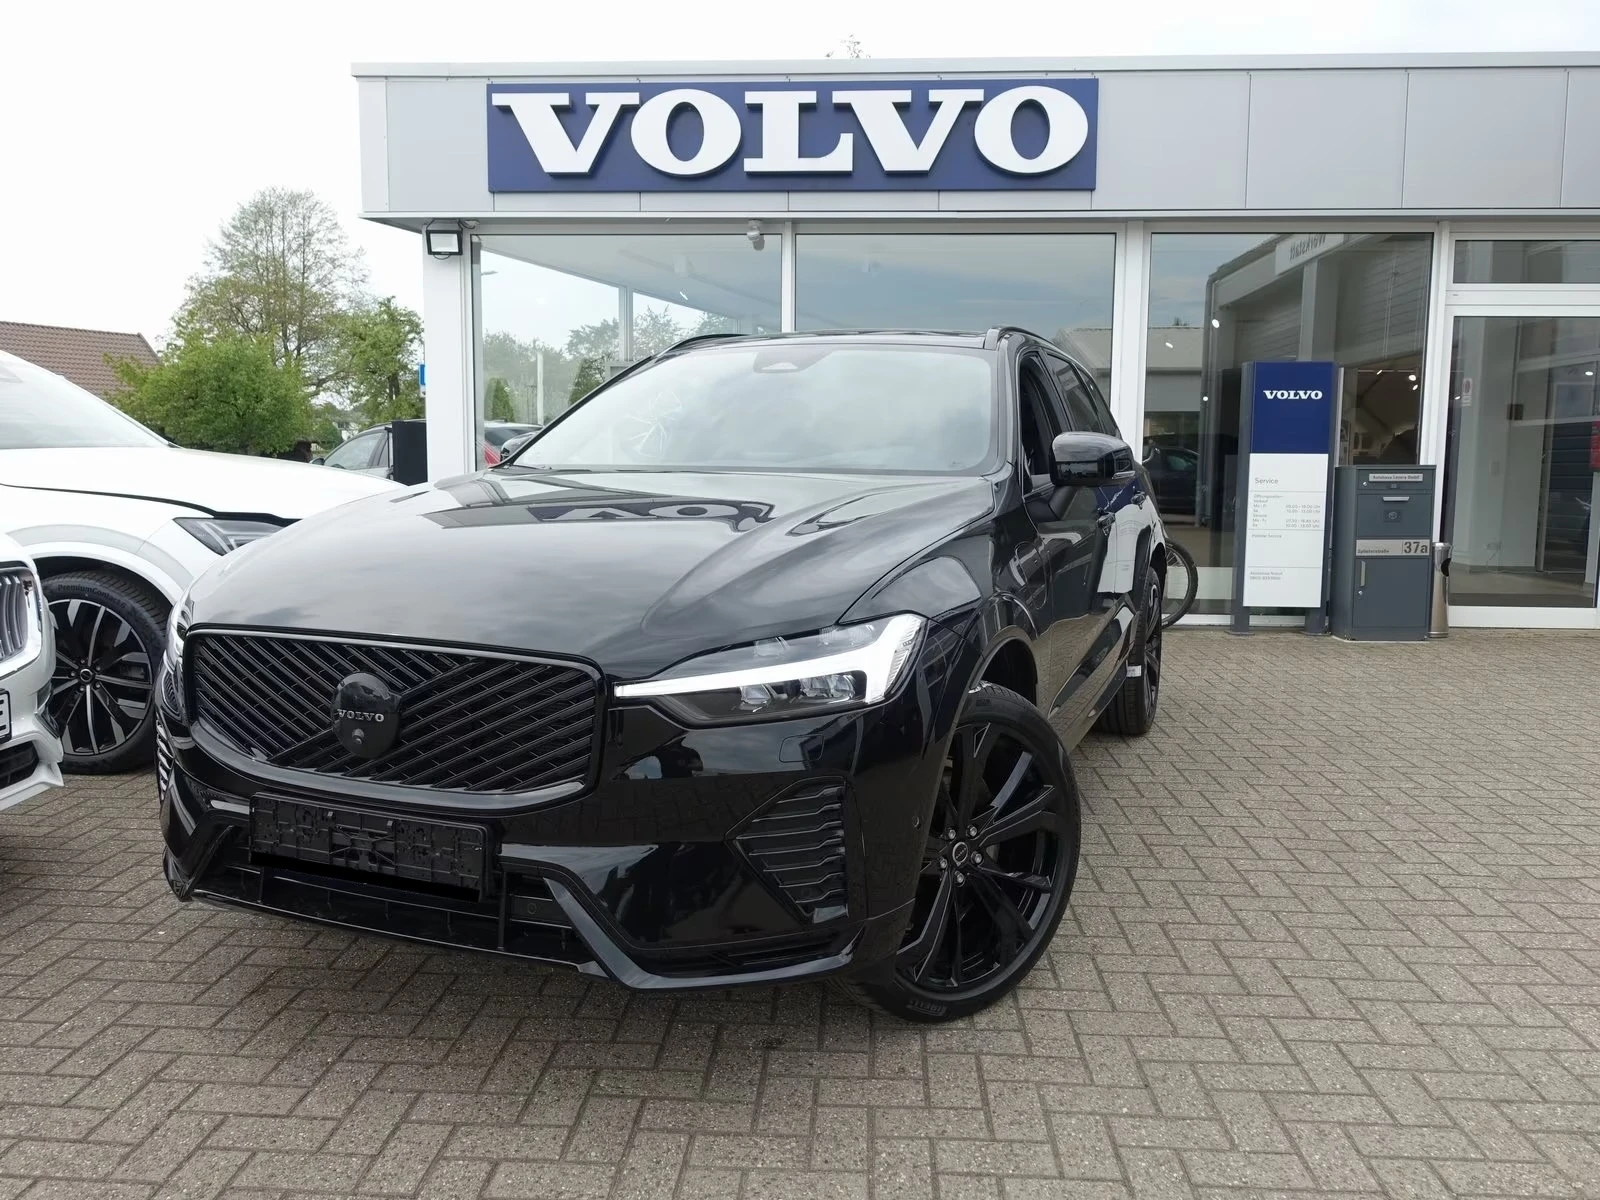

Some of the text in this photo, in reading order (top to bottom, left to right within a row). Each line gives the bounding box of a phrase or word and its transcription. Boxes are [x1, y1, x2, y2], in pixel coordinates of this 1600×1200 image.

[491, 85, 1089, 176] VOLVO
[1263, 390, 1323, 400] VOLVO
[1255, 477, 1279, 485] Service
[1404, 541, 1428, 553] 37a
[336, 708, 385, 722] VOLVO
